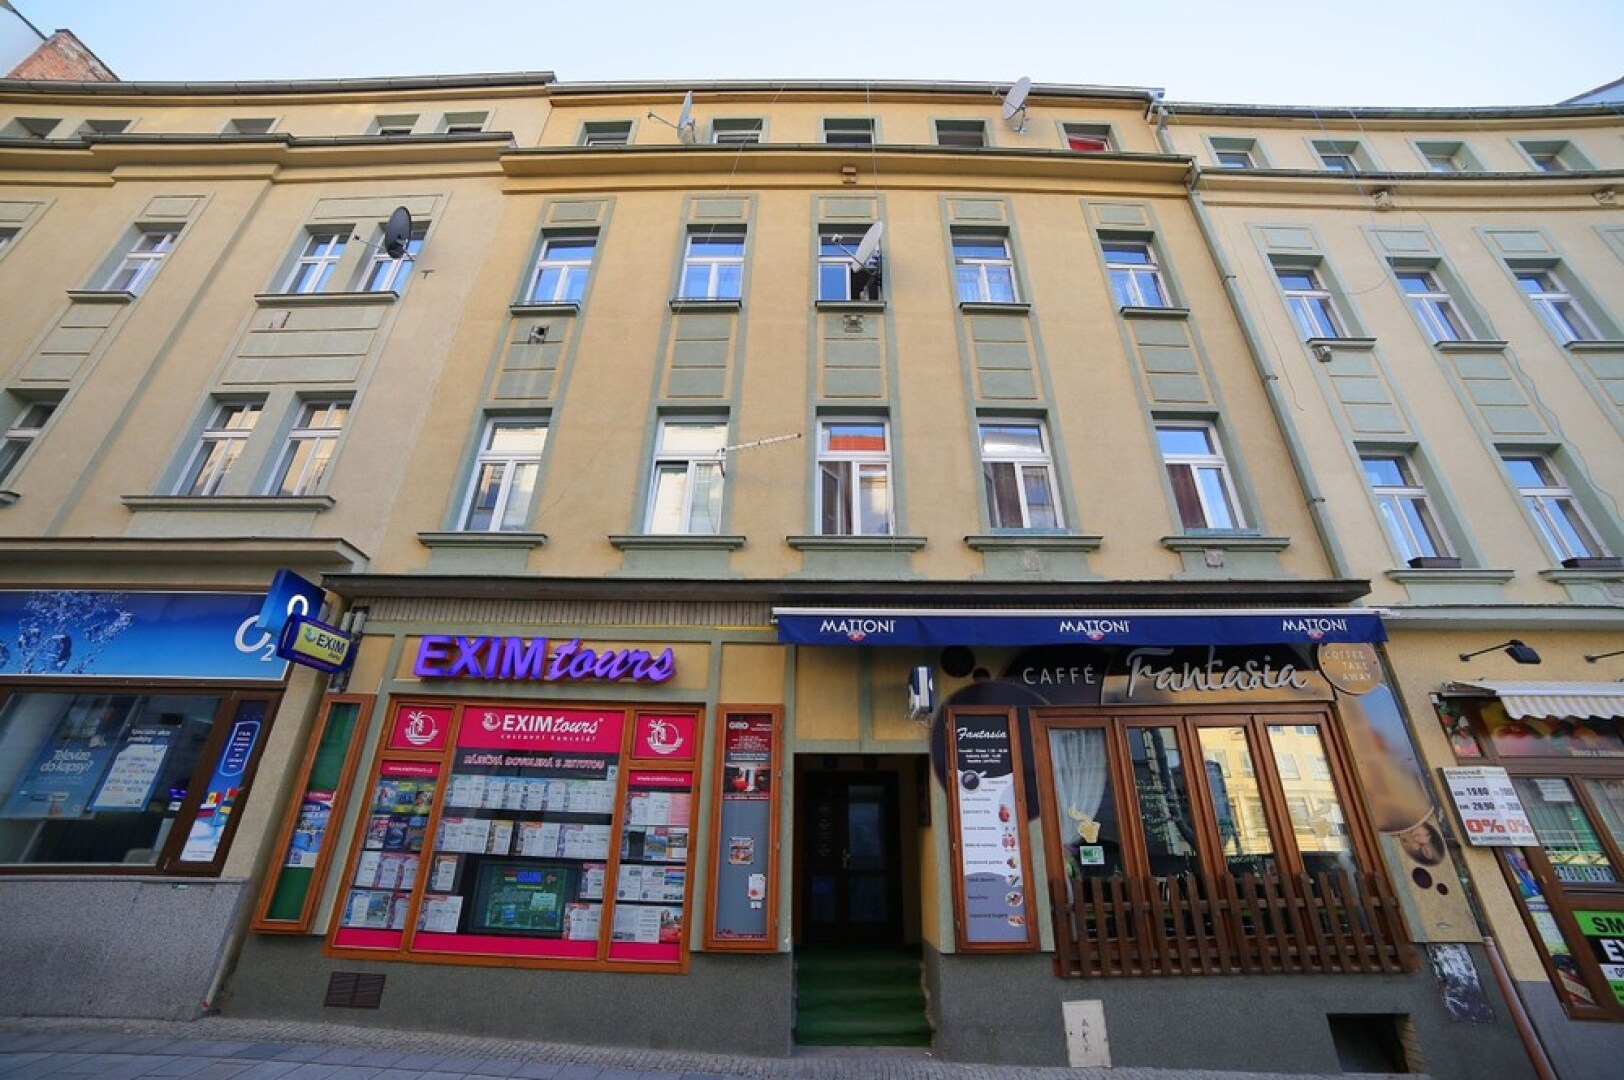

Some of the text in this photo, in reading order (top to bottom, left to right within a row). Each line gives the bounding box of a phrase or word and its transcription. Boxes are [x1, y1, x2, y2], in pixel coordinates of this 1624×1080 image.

[820, 619, 897, 634] MATTONI
[1059, 619, 1130, 634] MATTONI
[1282, 618, 1347, 633] MATTONI
[316, 633, 345, 655] EXIM
[1325, 650, 1366, 660] COFFEE
[1023, 645, 1308, 697] CAFFÉ Fantasia
[1342, 661, 1370, 670] TAKE
[1342, 673, 1372, 681] AWAY
[955, 727, 1008, 741] Fantasia
